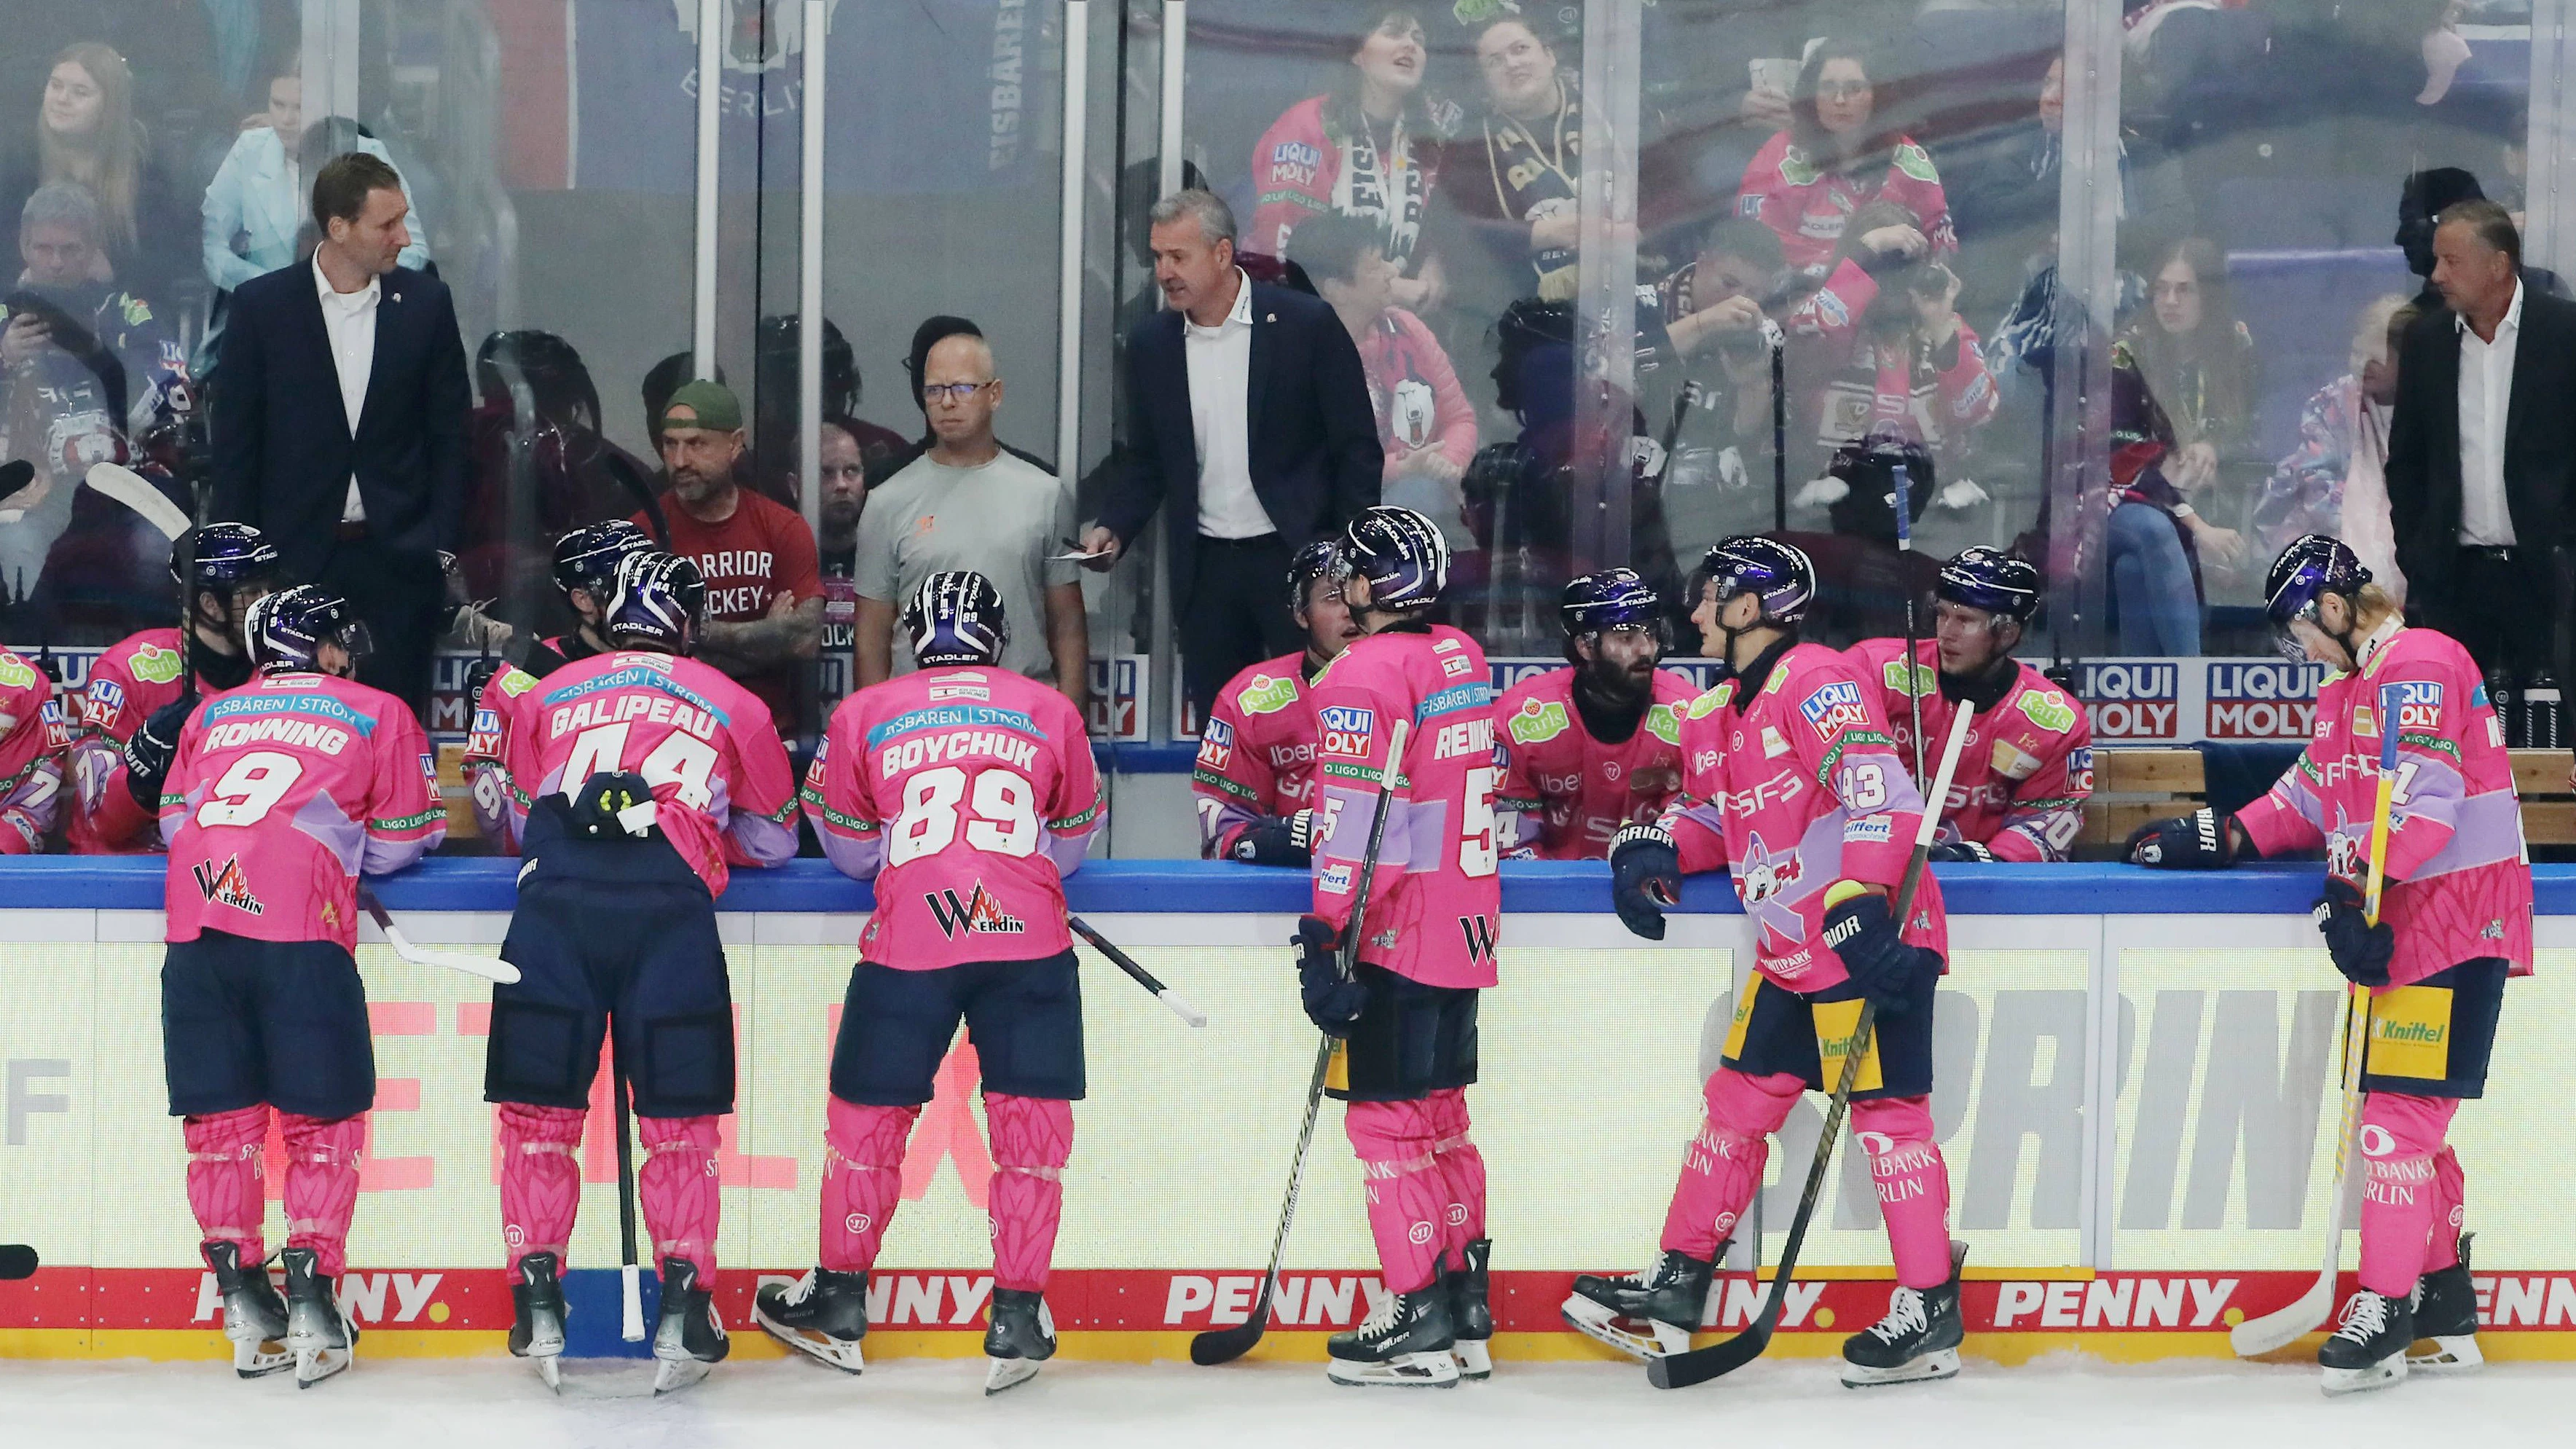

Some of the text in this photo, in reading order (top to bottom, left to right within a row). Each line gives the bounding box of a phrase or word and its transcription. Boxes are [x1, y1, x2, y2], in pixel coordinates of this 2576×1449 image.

[1762, 579, 1798, 600] STADLER
[962, 611, 978, 624] 89
[280, 627, 316, 643] STADLER
[612, 622, 664, 637] STADLER
[922, 654, 979, 664] STADLER
[1803, 683, 1862, 718] LIQUI
[551, 695, 719, 740] GALIPEAU
[1821, 704, 1869, 737] MOLY
[2023, 696, 2070, 729] Karls
[1515, 712, 1563, 739] Karls
[201, 717, 350, 756] RONNING
[881, 731, 1039, 781] BOYCHUK
[1335, 765, 1359, 777] LIGO
[196, 751, 304, 829] 9
[1220, 777, 1239, 793] LIGO
[382, 820, 407, 829] LIGO
[825, 809, 869, 830] LIGO LIGO
[888, 766, 1040, 868] 89
[1064, 815, 1083, 828] LIGO
[2383, 1021, 2446, 1043] Knittel
